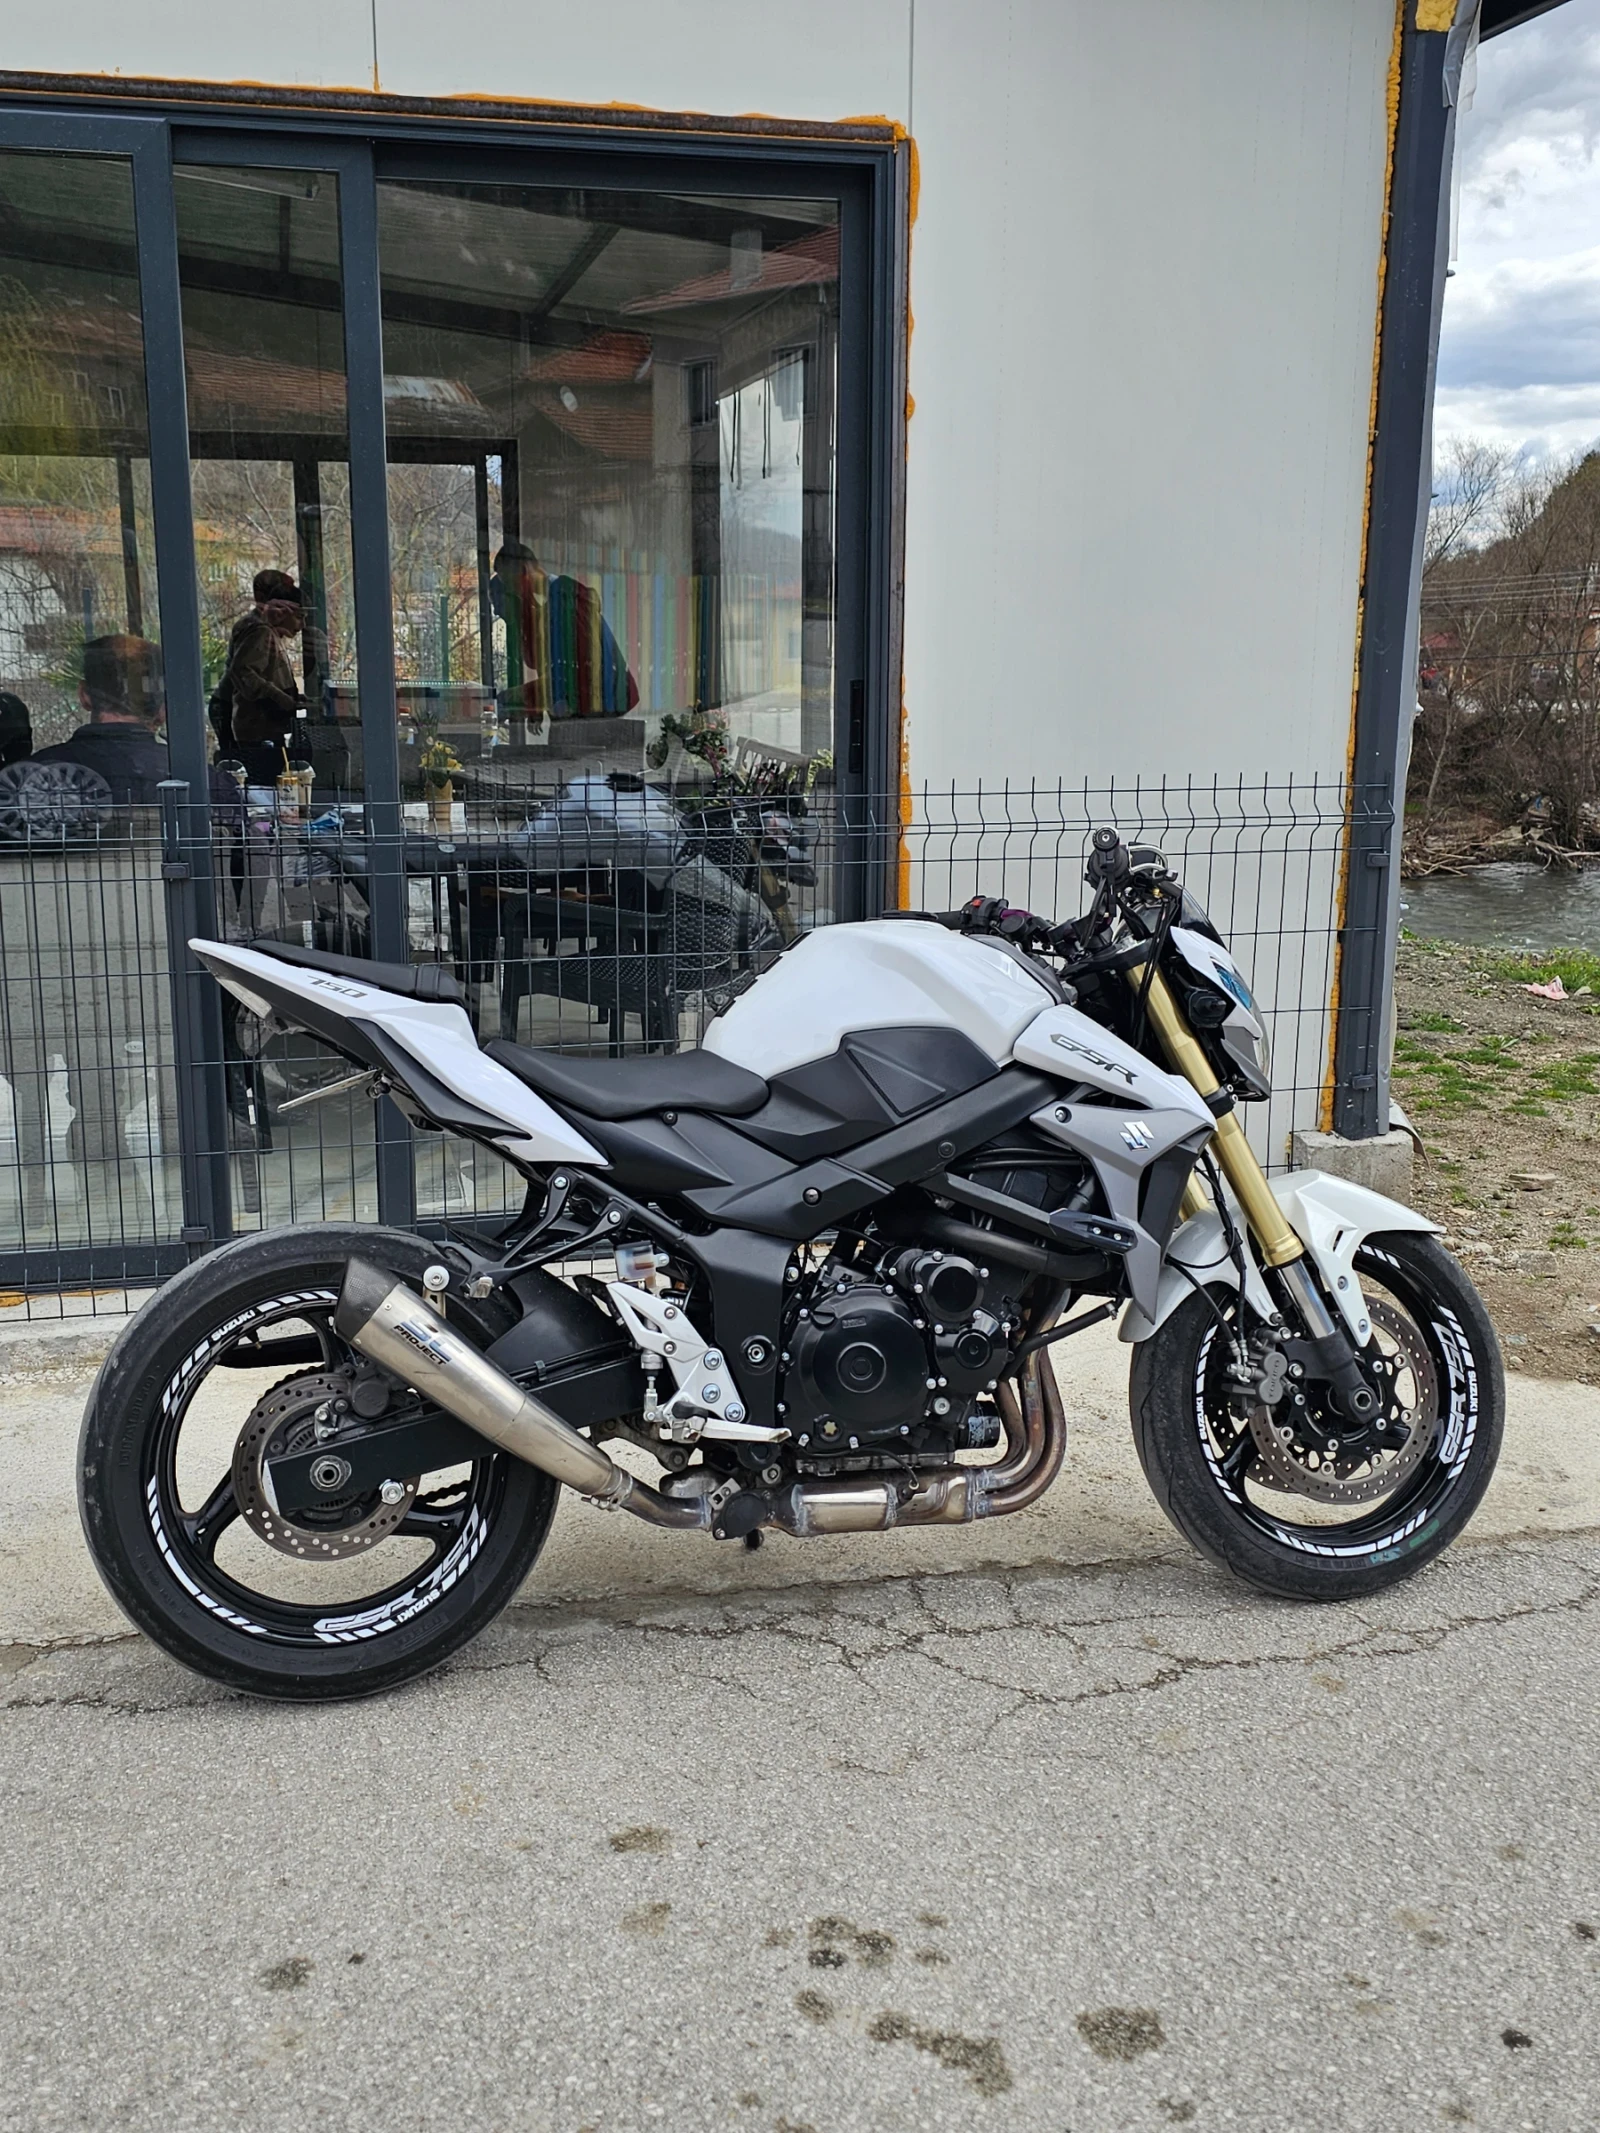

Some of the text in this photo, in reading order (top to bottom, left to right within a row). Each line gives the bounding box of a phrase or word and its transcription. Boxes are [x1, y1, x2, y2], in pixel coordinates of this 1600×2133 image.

[307, 975, 368, 998] 750
[1050, 1033, 1138, 1085] GSR
[211, 1309, 256, 1342] SUZUKI
[394, 1325, 447, 1366] PROJECT
[1431, 1321, 1466, 1464] GSR 750
[1467, 1370, 1478, 1412] SUZUKI
[1196, 1396, 1207, 1440] SUZUKI
[313, 1503, 479, 1632] GSR 750
[398, 1588, 441, 1623] SUZUKI
